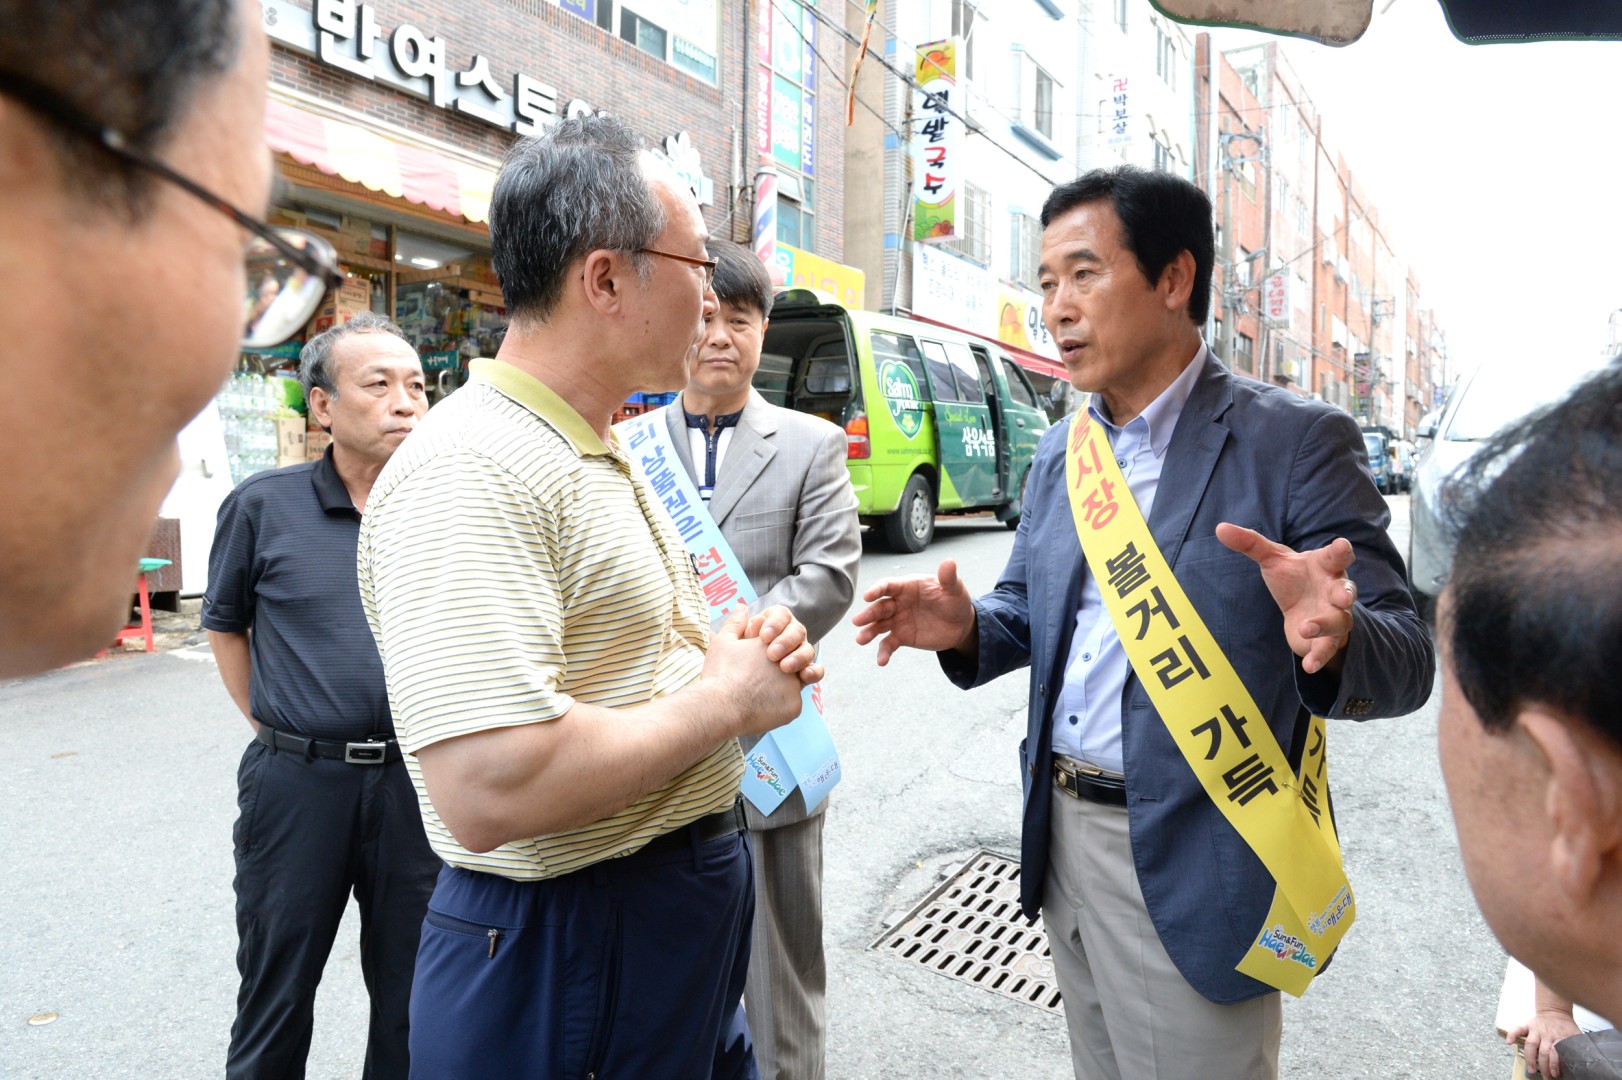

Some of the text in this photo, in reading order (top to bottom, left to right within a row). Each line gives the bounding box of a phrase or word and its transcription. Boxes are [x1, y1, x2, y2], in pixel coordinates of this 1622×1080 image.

[313, 0, 607, 135] 반여스토
[1112, 93, 1128, 134] 박보살
[697, 546, 748, 616] 전통
[1105, 541, 1211, 690] 볼거리
[1191, 704, 1279, 807] 가득
[1258, 930, 1316, 968] Haeundae
[1273, 929, 1304, 950] Sun&Fun
